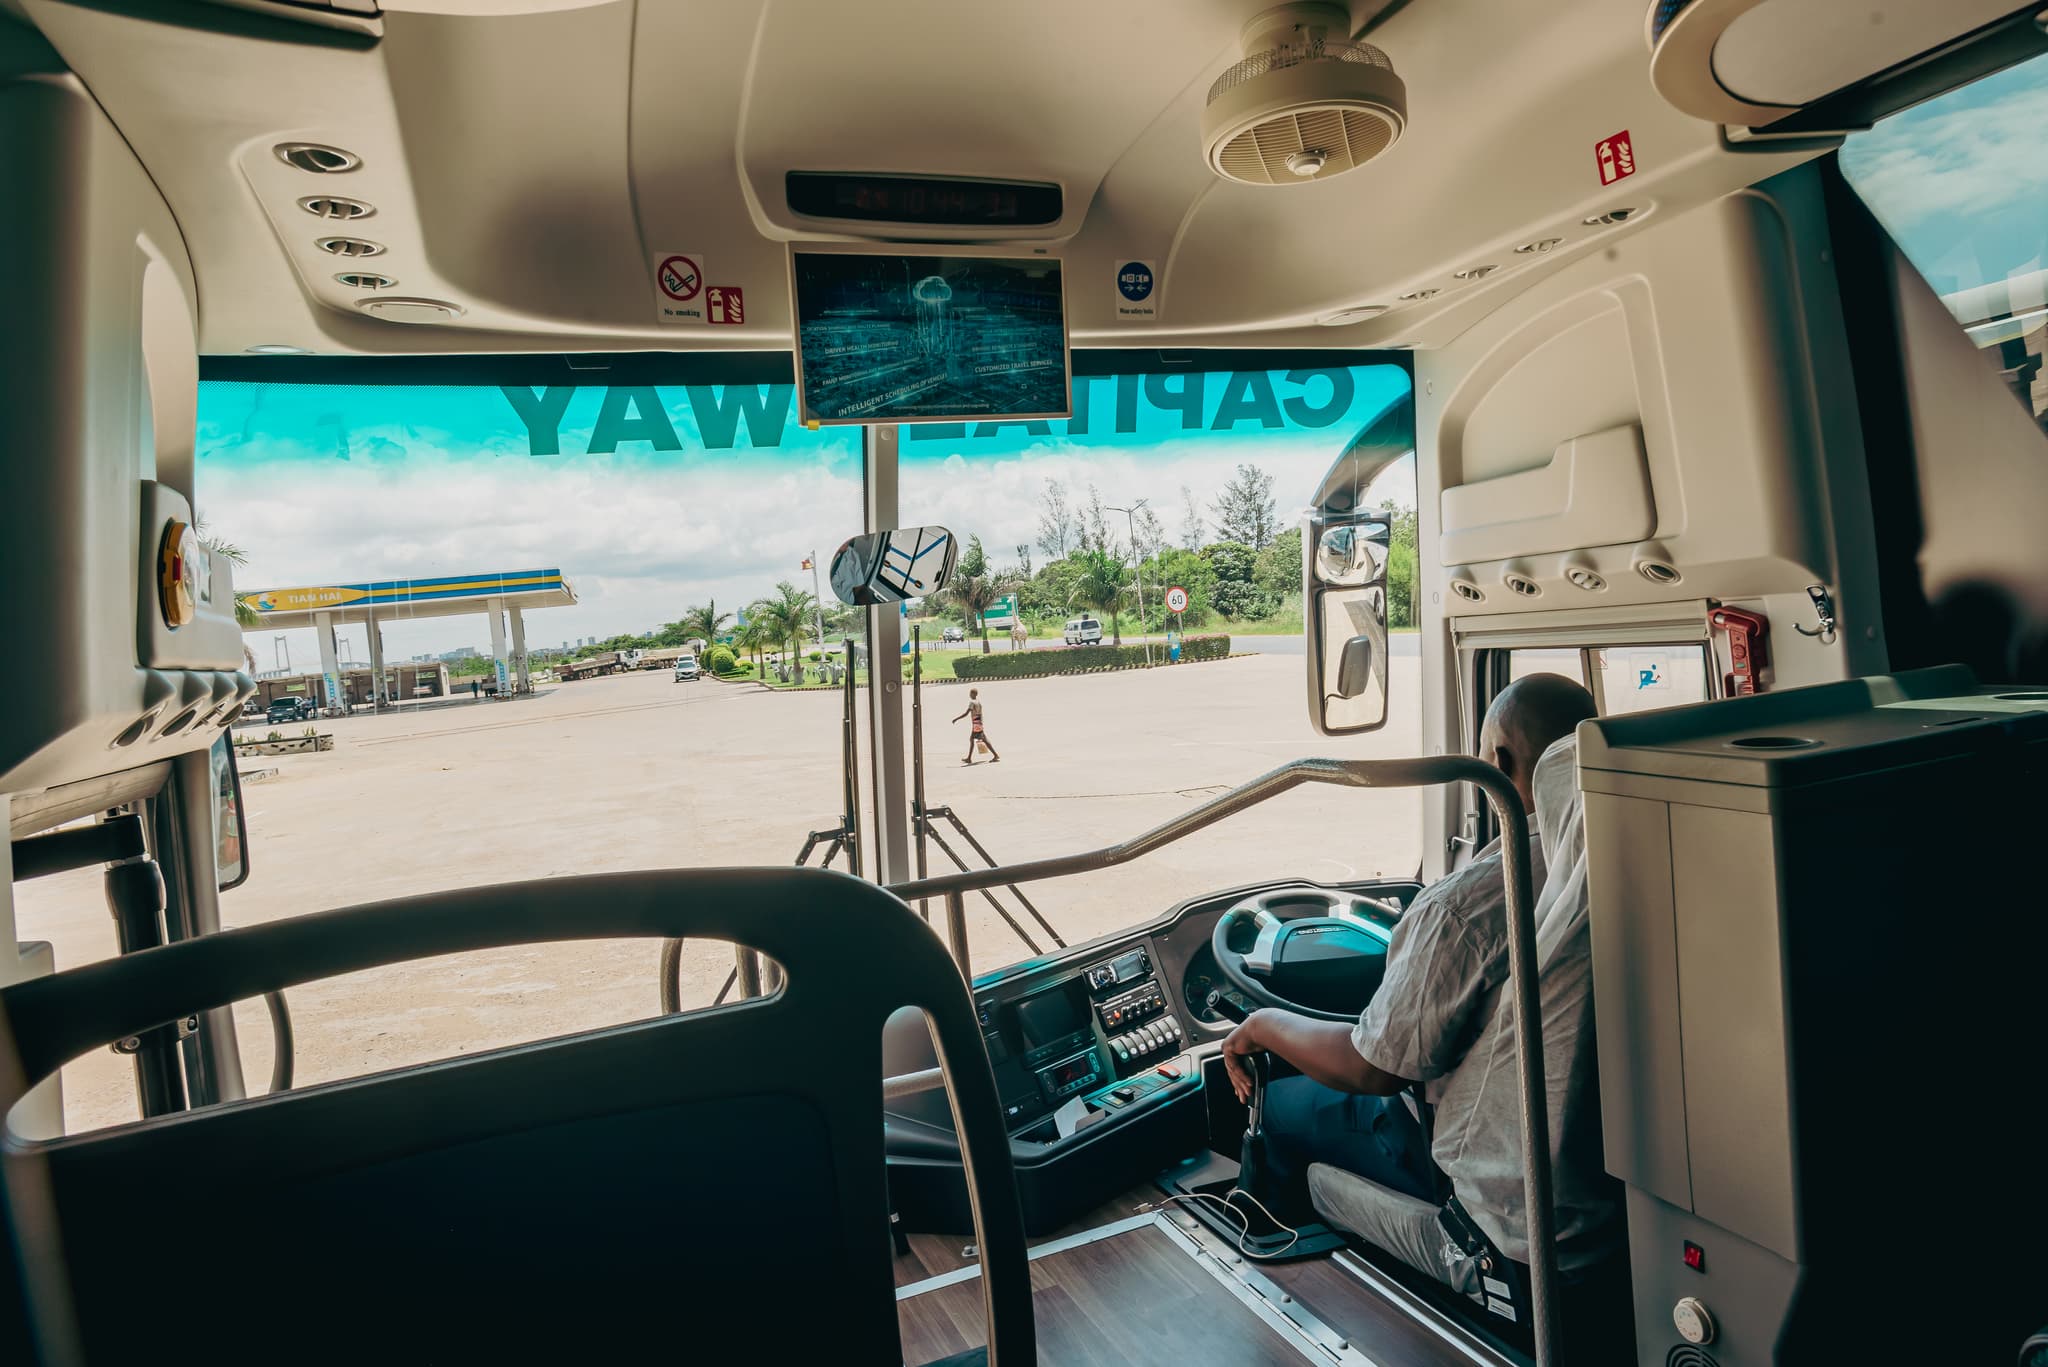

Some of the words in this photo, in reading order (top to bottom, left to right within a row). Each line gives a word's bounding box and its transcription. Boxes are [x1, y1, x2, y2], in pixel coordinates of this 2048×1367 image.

[664, 308, 674, 316] No
[675, 308, 701, 318] smoking
[824, 345, 846, 355] DRIVER
[974, 363, 1010, 373] CUSTOMIZED
[1010, 361, 1030, 370] TRAVEL
[1030, 359, 1053, 368] SERVICES
[838, 394, 884, 417] INTELLIGENT
[884, 382, 920, 400] SCHEDULING
[287, 593, 317, 604] TIAN
[1172, 594, 1183, 605] 60
